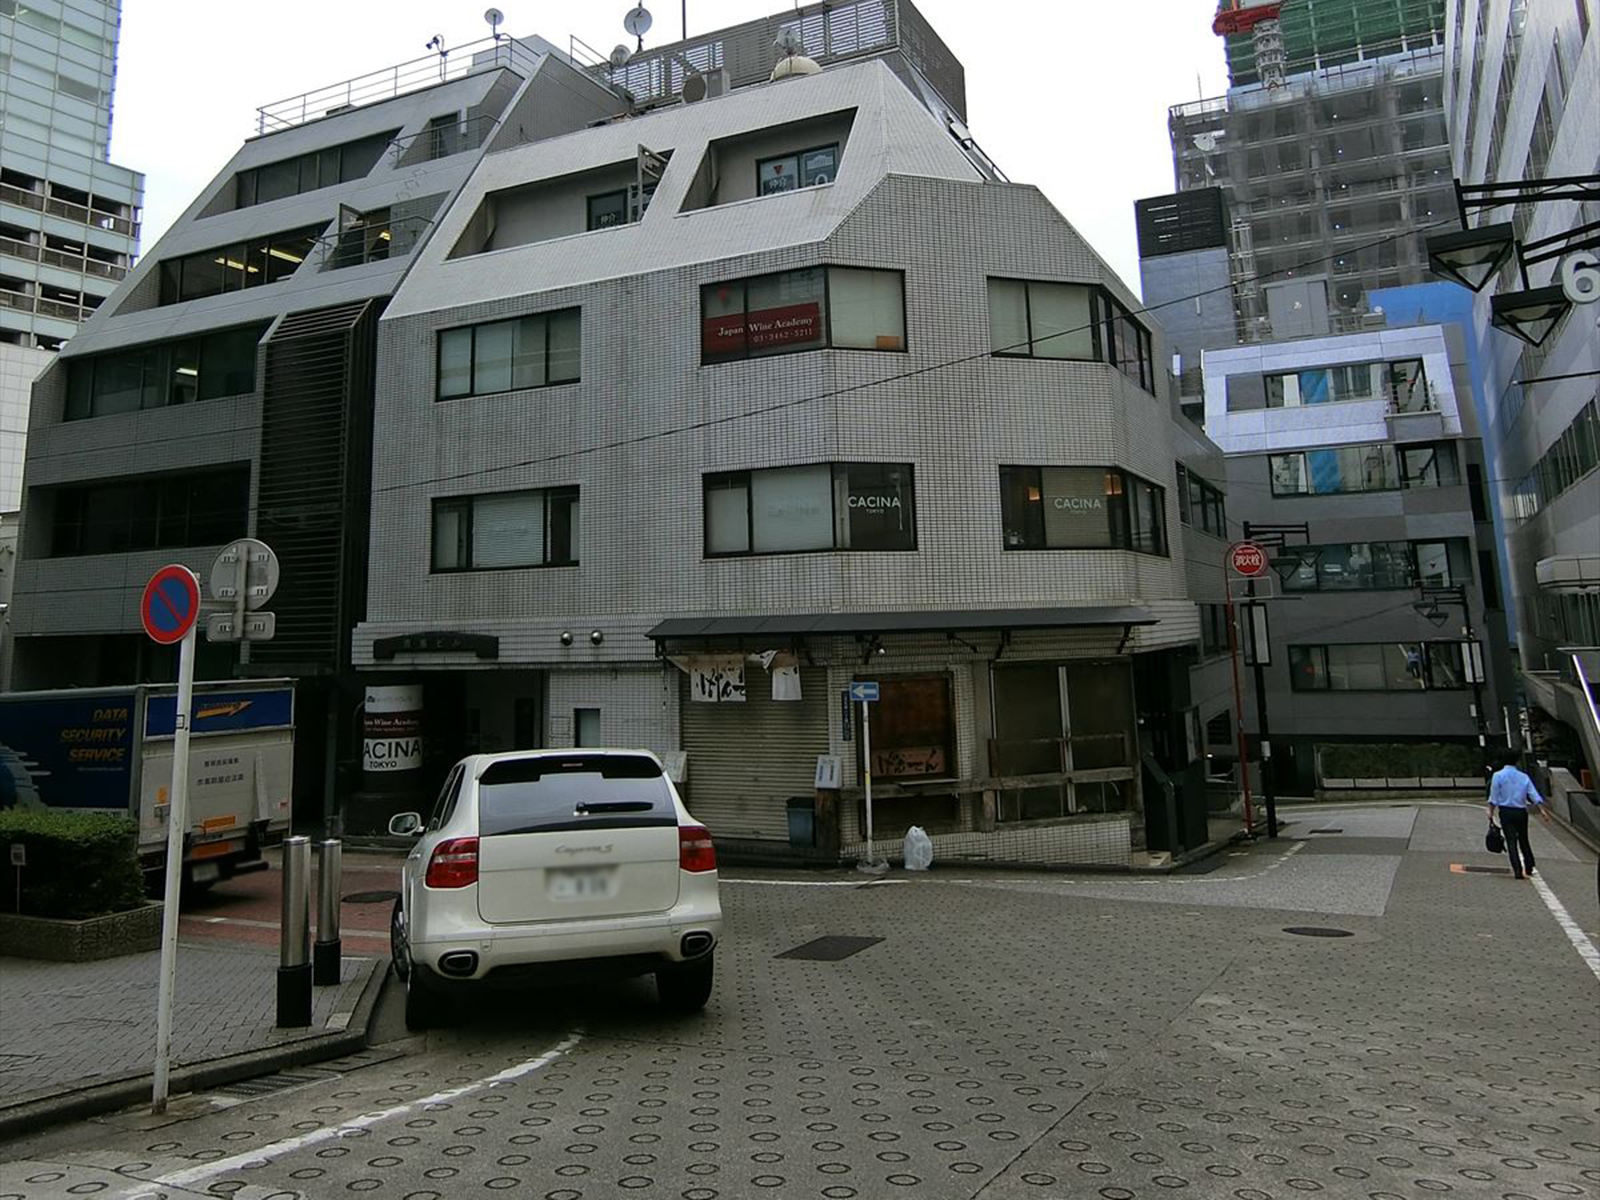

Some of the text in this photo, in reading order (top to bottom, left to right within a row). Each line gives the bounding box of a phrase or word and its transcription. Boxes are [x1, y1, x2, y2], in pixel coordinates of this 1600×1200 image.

[1562, 252, 1600, 304] 6
[717, 316, 813, 337] Japan Wine Academy
[847, 496, 901, 508] CACINA
[1054, 498, 1102, 509] CACINA
[1235, 553, 1260, 566] 消火栓
[92, 708, 128, 721] DATA
[60, 728, 126, 742] SECURITY
[68, 748, 125, 762] SERVICE
[369, 760, 397, 769] TOKYO
